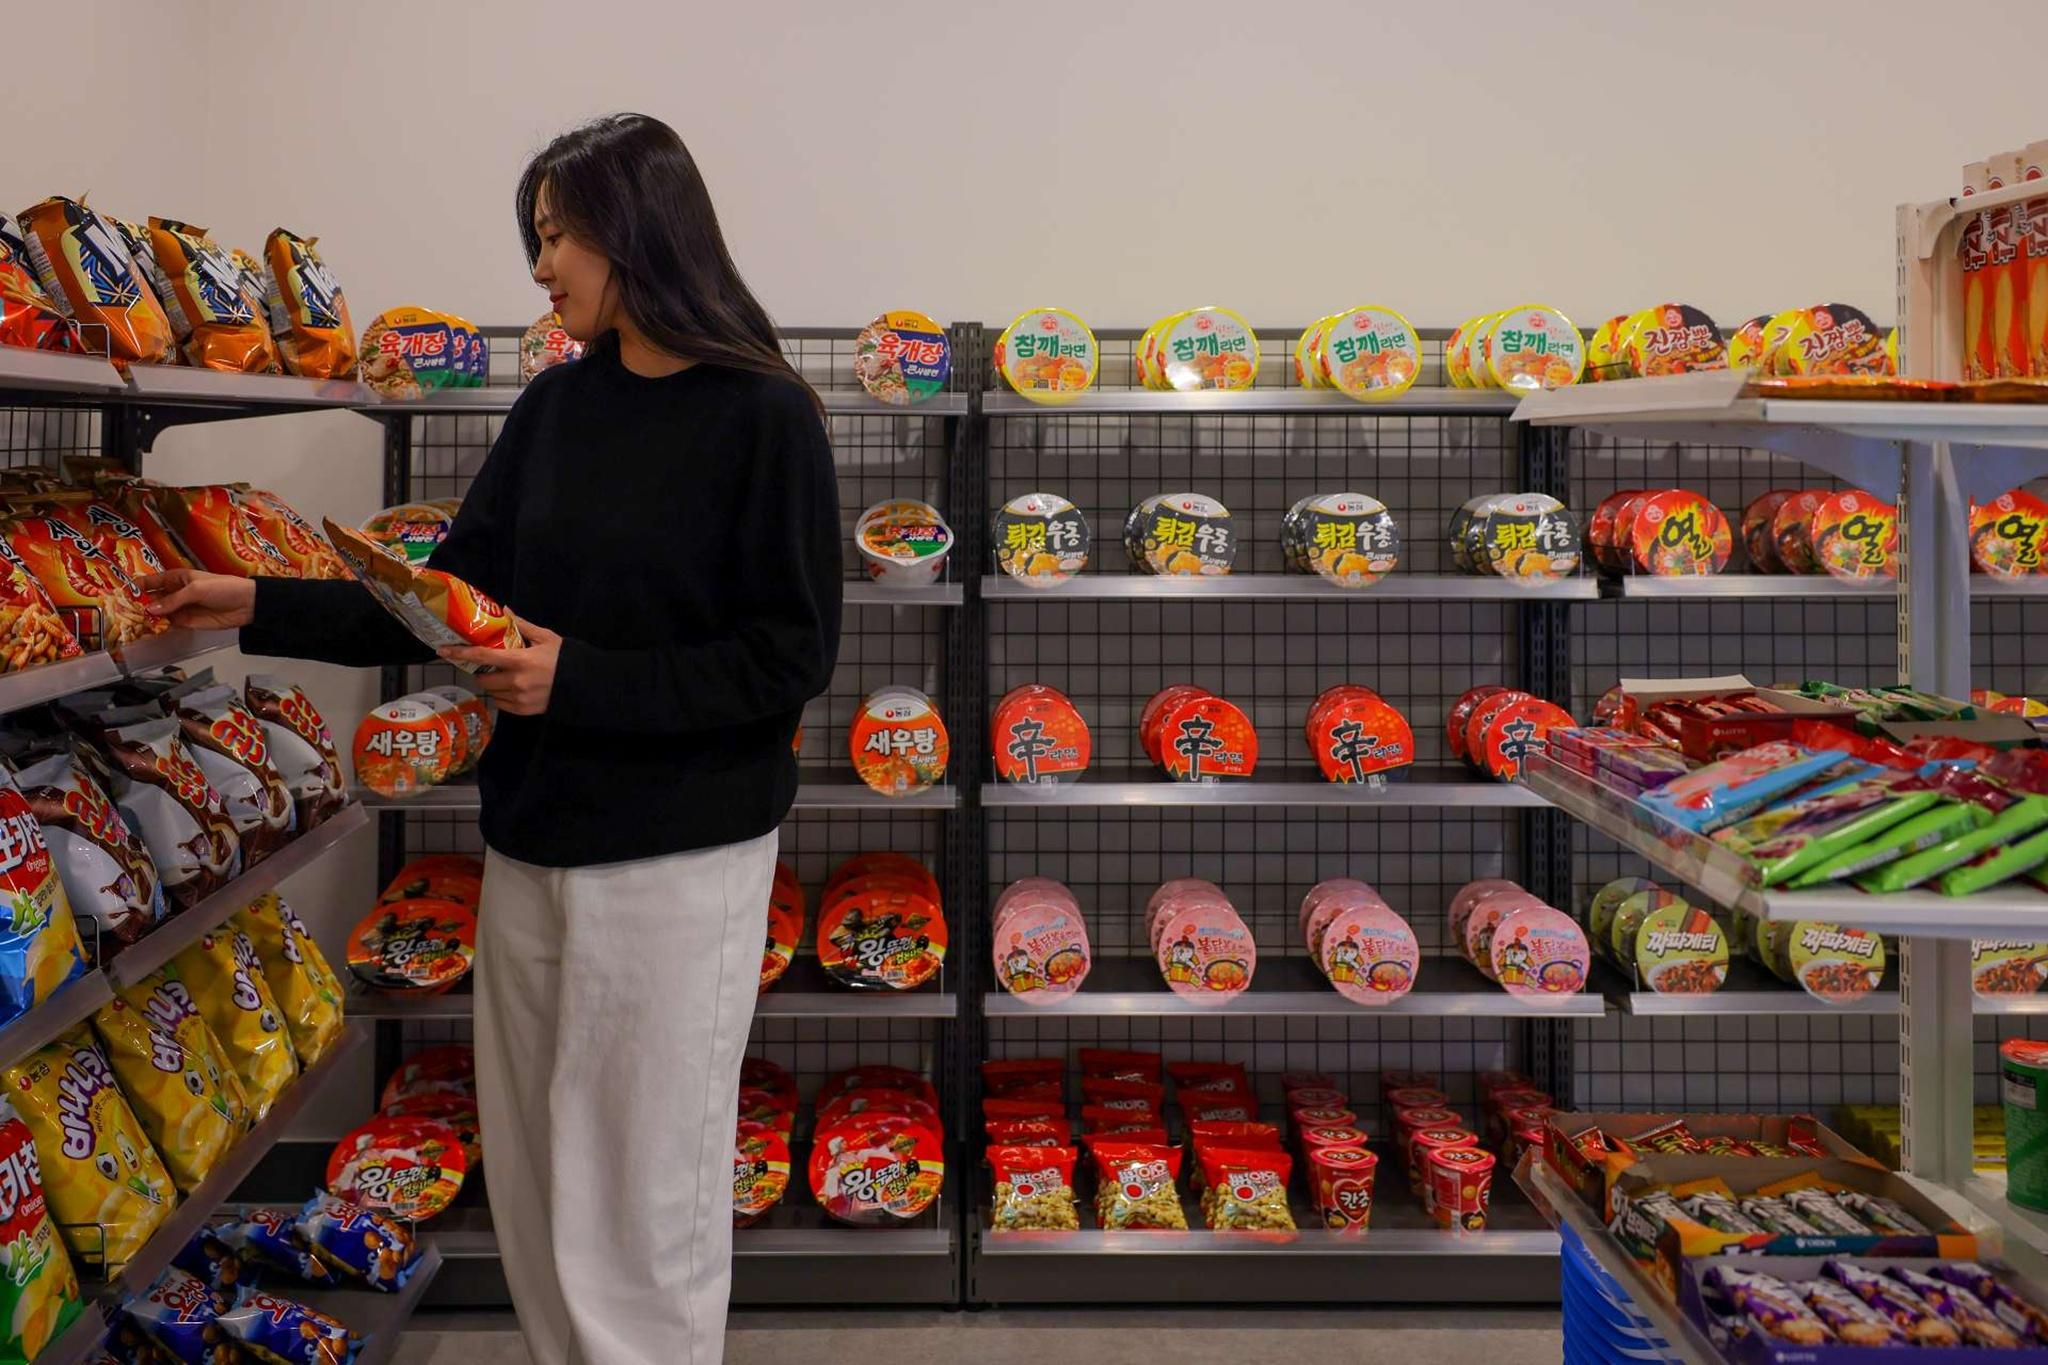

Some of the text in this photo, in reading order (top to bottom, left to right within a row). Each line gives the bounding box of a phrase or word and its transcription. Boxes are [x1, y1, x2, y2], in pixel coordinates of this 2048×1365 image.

[380, 330, 448, 357] 육개장
[876, 331, 944, 365] 육개장
[1015, 332, 1087, 359] 참깨라면
[1172, 333, 1246, 362] 참깨라면
[1333, 330, 1406, 364] 참깨라면
[1500, 328, 1575, 356] 참깨라면
[365, 729, 440, 758] 새우탕
[864, 727, 938, 757] 새우탕
[1173, 713, 1223, 782] 辛
[1329, 718, 1379, 785] 辛
[1646, 930, 1718, 958] 짜파게티
[1800, 928, 1878, 958] 짜파게티
